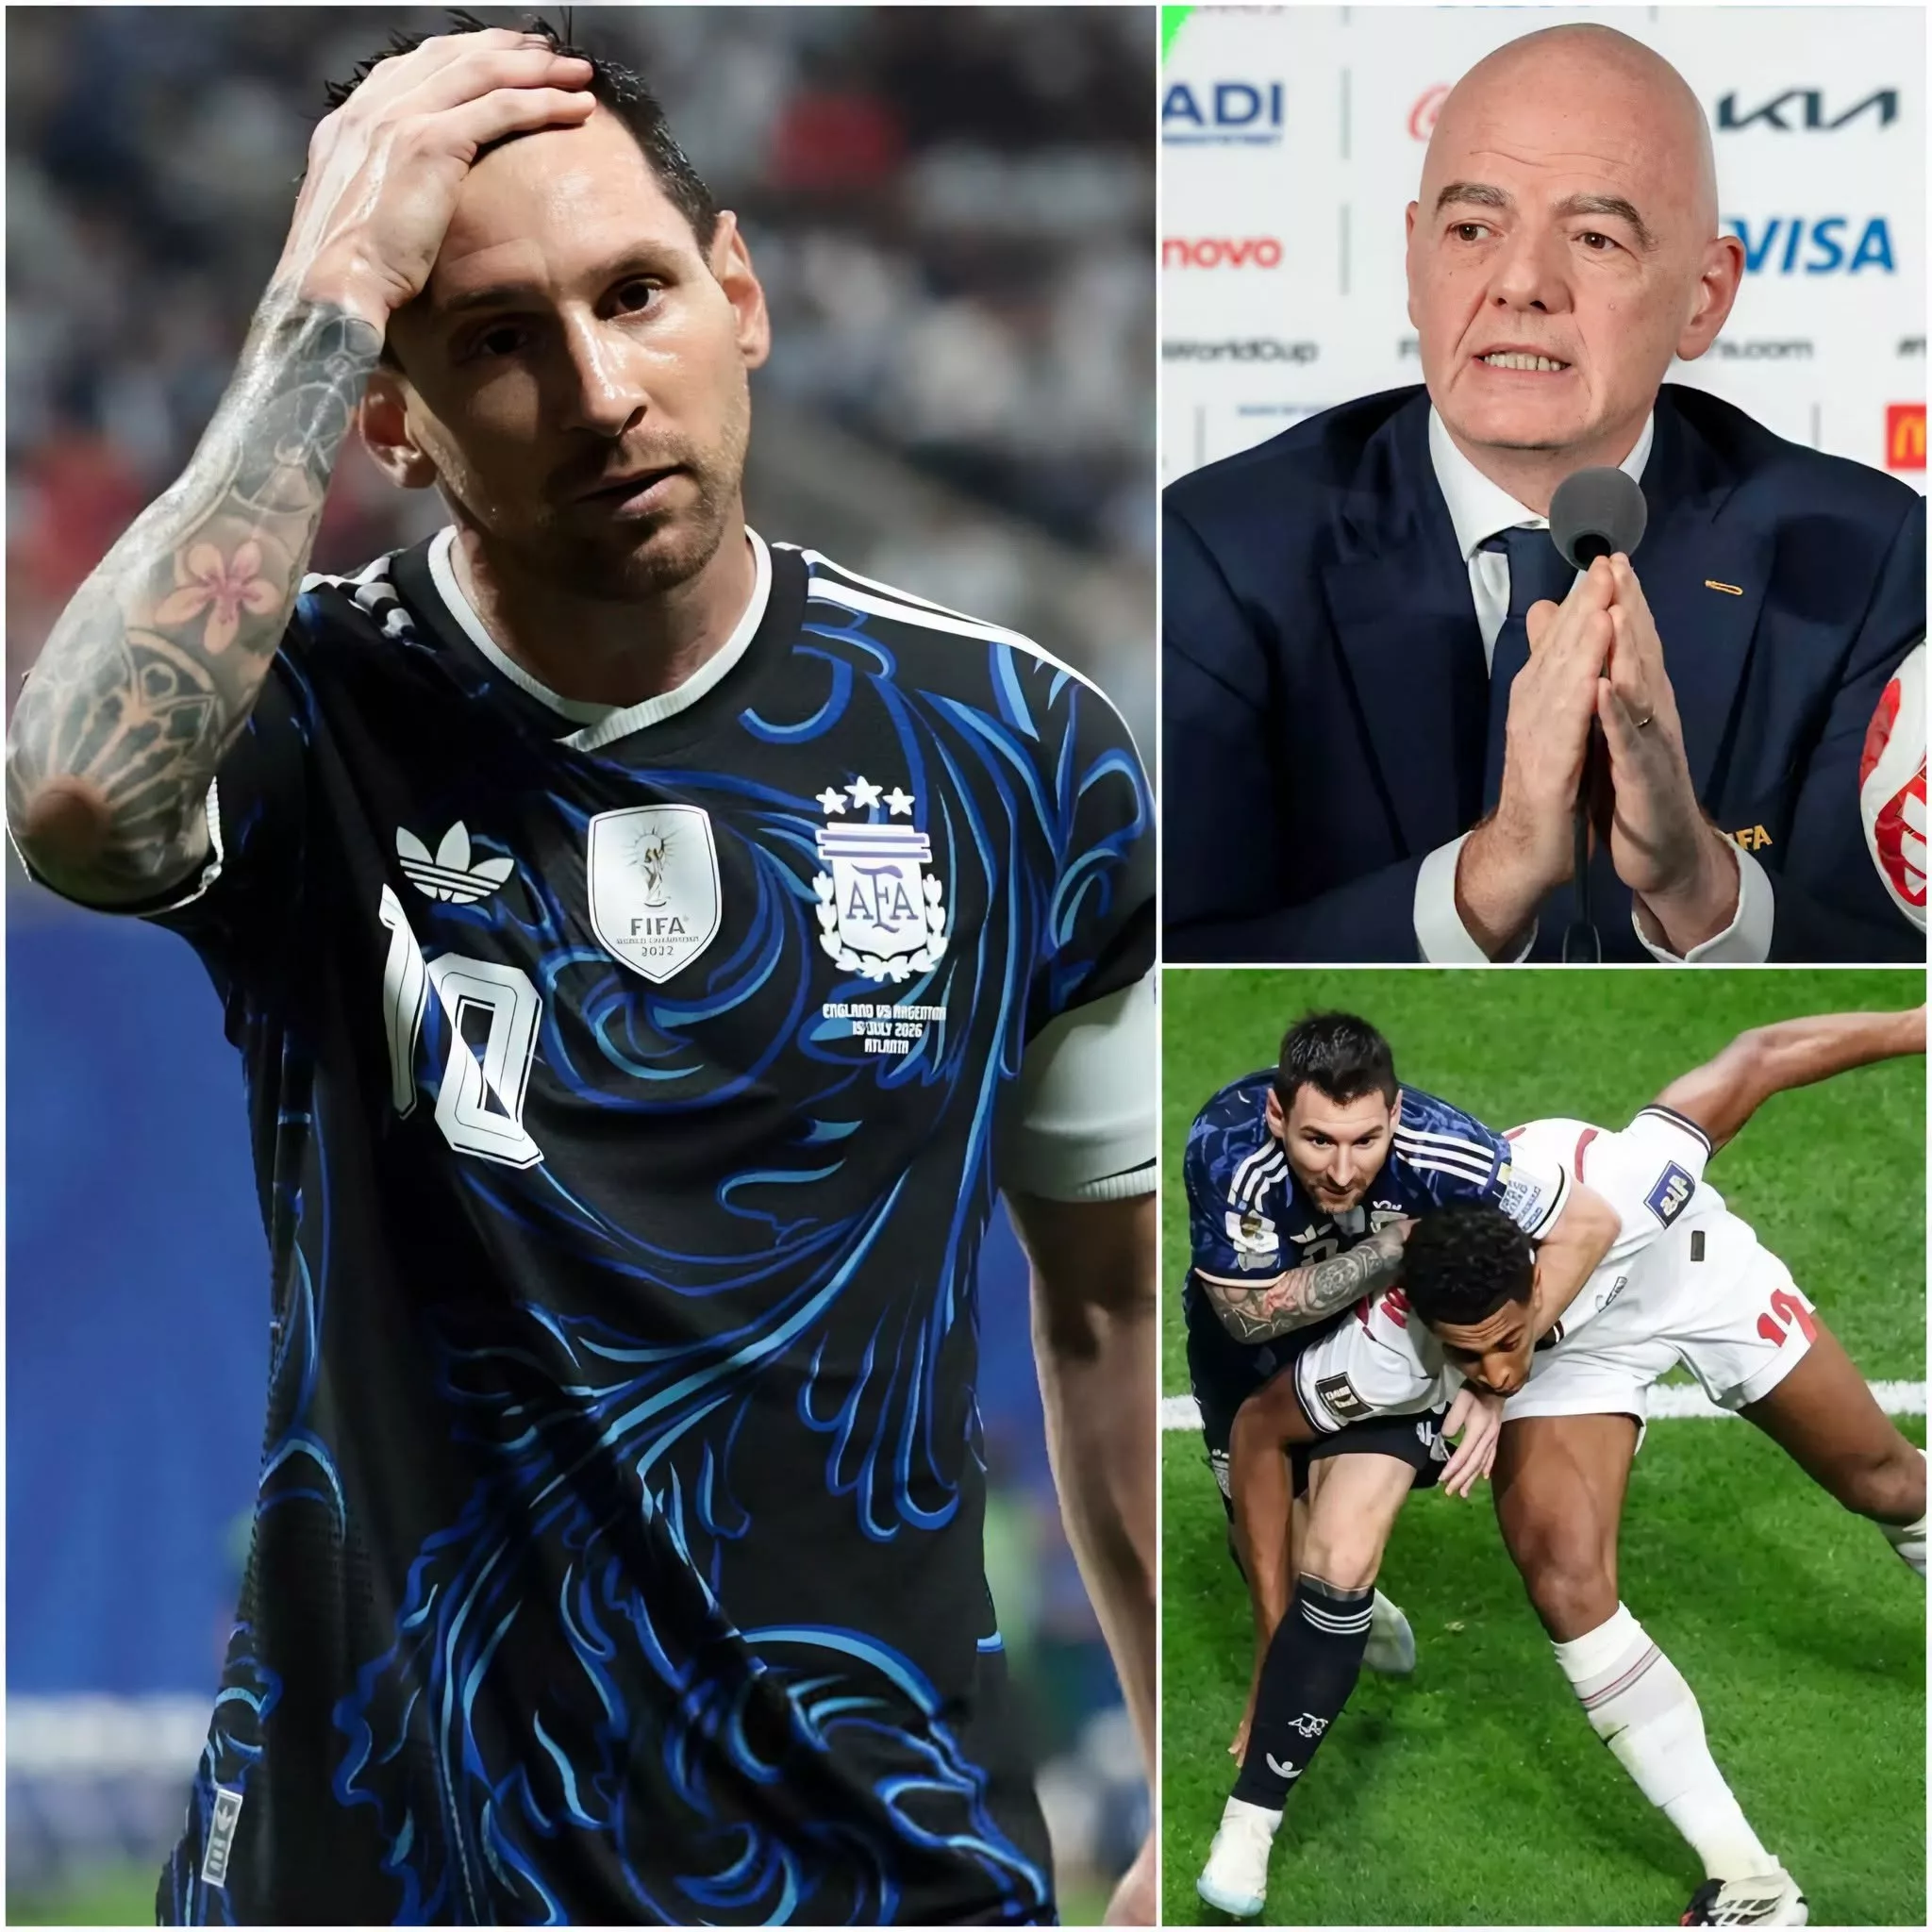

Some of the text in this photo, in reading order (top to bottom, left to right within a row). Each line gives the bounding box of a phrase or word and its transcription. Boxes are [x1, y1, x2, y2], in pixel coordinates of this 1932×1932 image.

[1162, 82, 1283, 126] ADI
[1719, 88, 1899, 130] KIA
[1726, 218, 1896, 273] VISA
[630, 916, 686, 936] FIFA
[378, 882, 544, 1170] 10
[823, 1003, 874, 1019] ENGLAND
[875, 1004, 892, 1019] VS
[894, 1022, 924, 1038] 2026
[864, 1038, 909, 1055] ATLANTA
